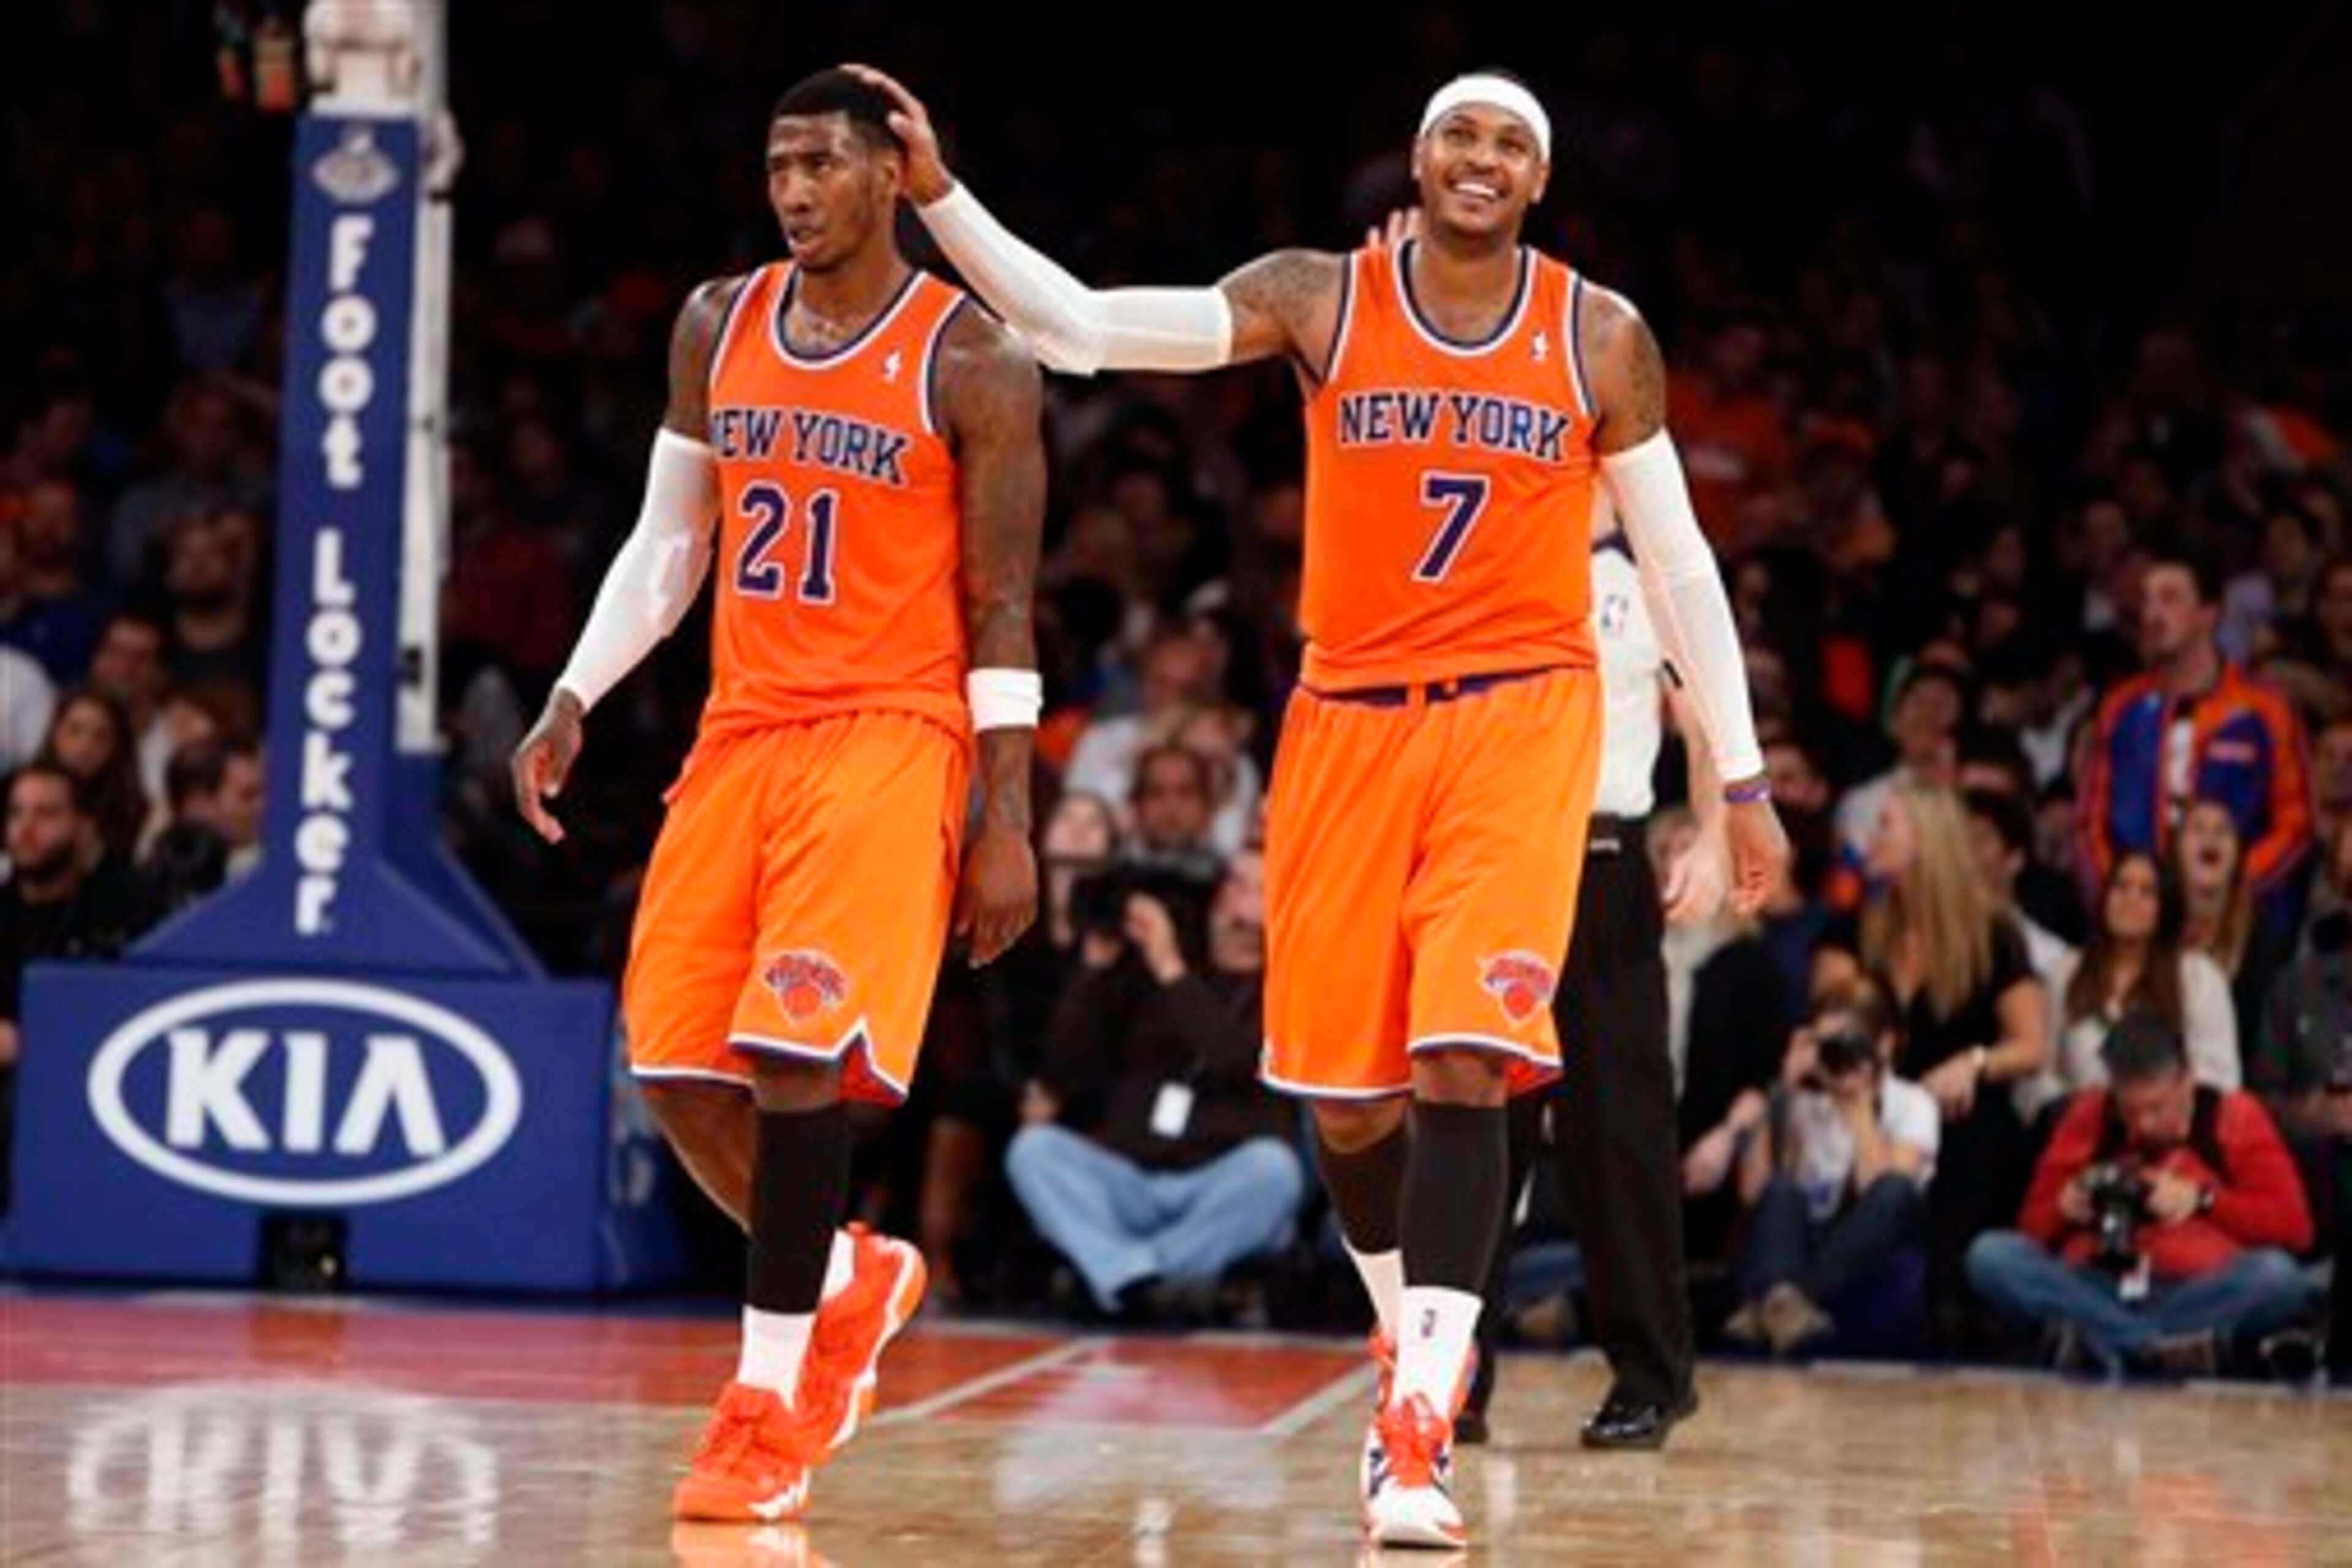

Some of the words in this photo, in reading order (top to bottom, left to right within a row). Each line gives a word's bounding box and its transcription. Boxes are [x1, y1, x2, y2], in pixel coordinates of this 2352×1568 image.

[319, 213, 375, 488] Foot
[793, 407, 909, 488] YORK
[1340, 387, 1441, 448] NEW
[1448, 392, 1570, 464] YORK
[737, 480, 840, 605] 21
[1412, 470, 1491, 583] 7
[295, 527, 361, 937] Locker
[165, 1027, 447, 1158] KIA
